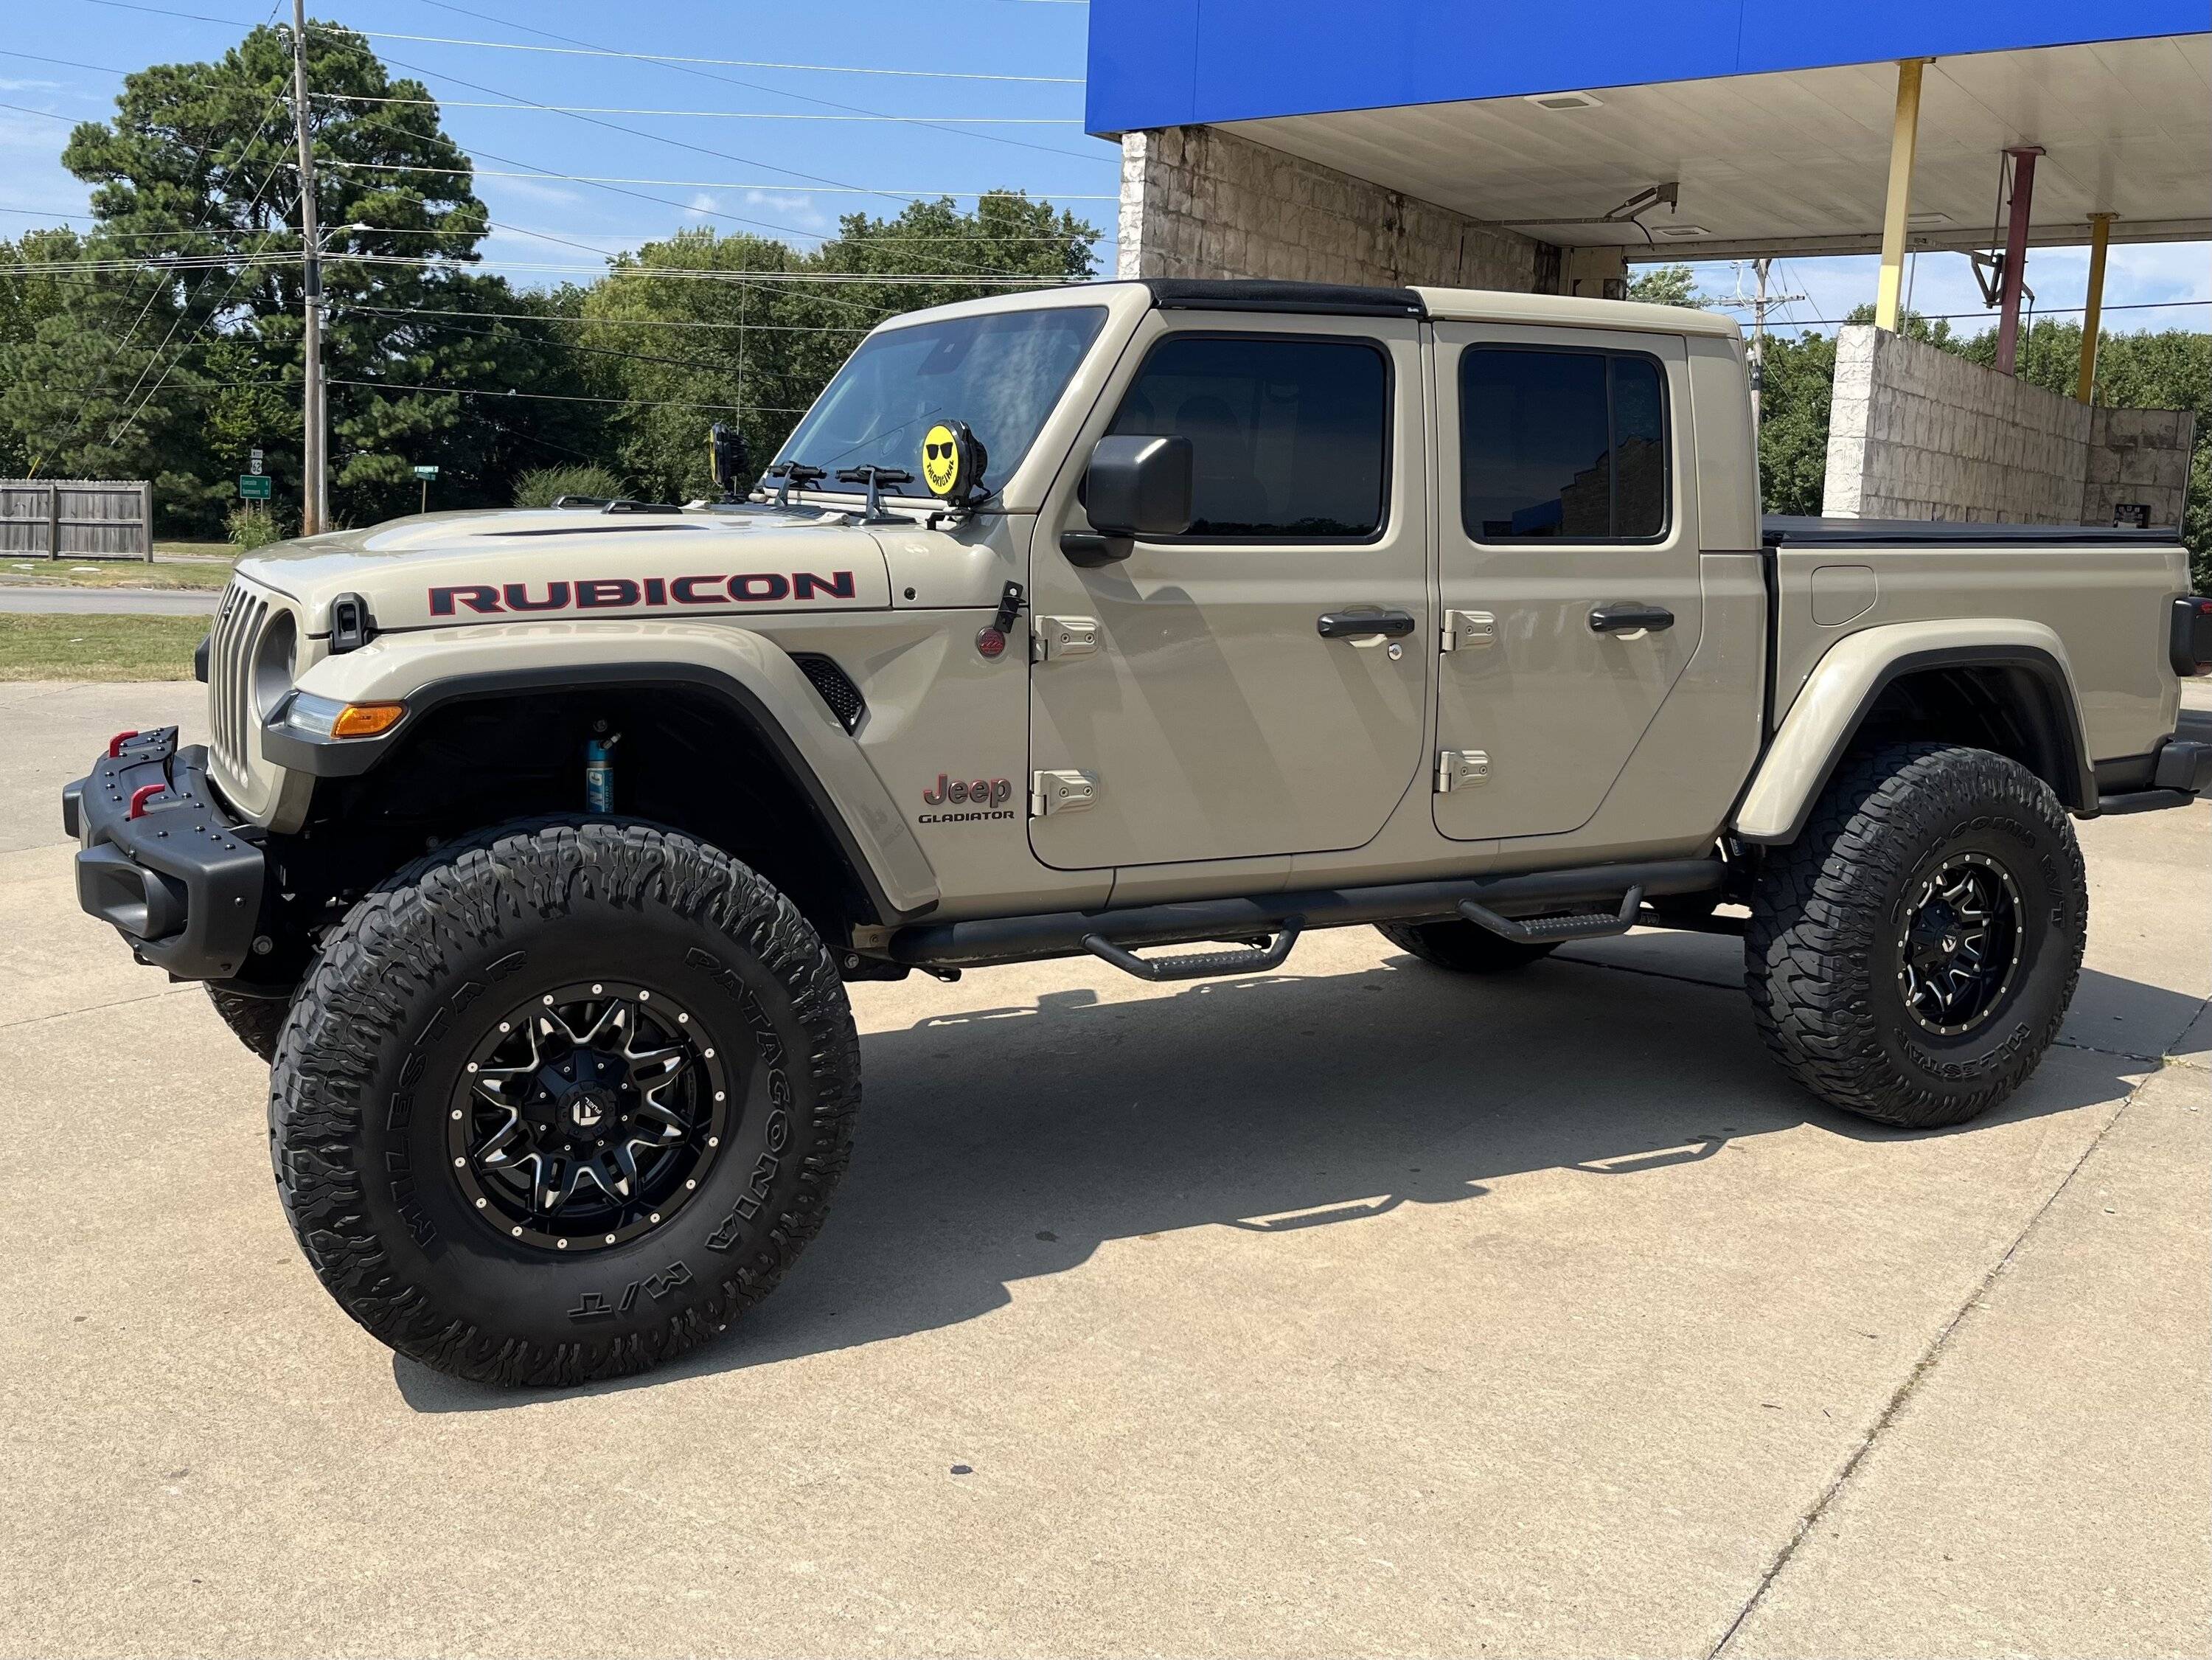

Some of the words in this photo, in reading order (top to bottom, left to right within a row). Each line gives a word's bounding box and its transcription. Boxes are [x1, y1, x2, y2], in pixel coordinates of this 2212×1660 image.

[252, 462, 261, 472] 62
[927, 462, 935, 479] THE
[933, 460, 953, 487] ORIGINAL
[428, 571, 856, 617] RUBICON
[923, 774, 1012, 808] Jeep
[918, 811, 1015, 824] GLADIATOR
[384, 949, 529, 1250] MILESTAR
[585, 1097, 602, 1114] FUEL
[683, 947, 793, 1252] PATAGONIA
[567, 1260, 693, 1322] M/T
